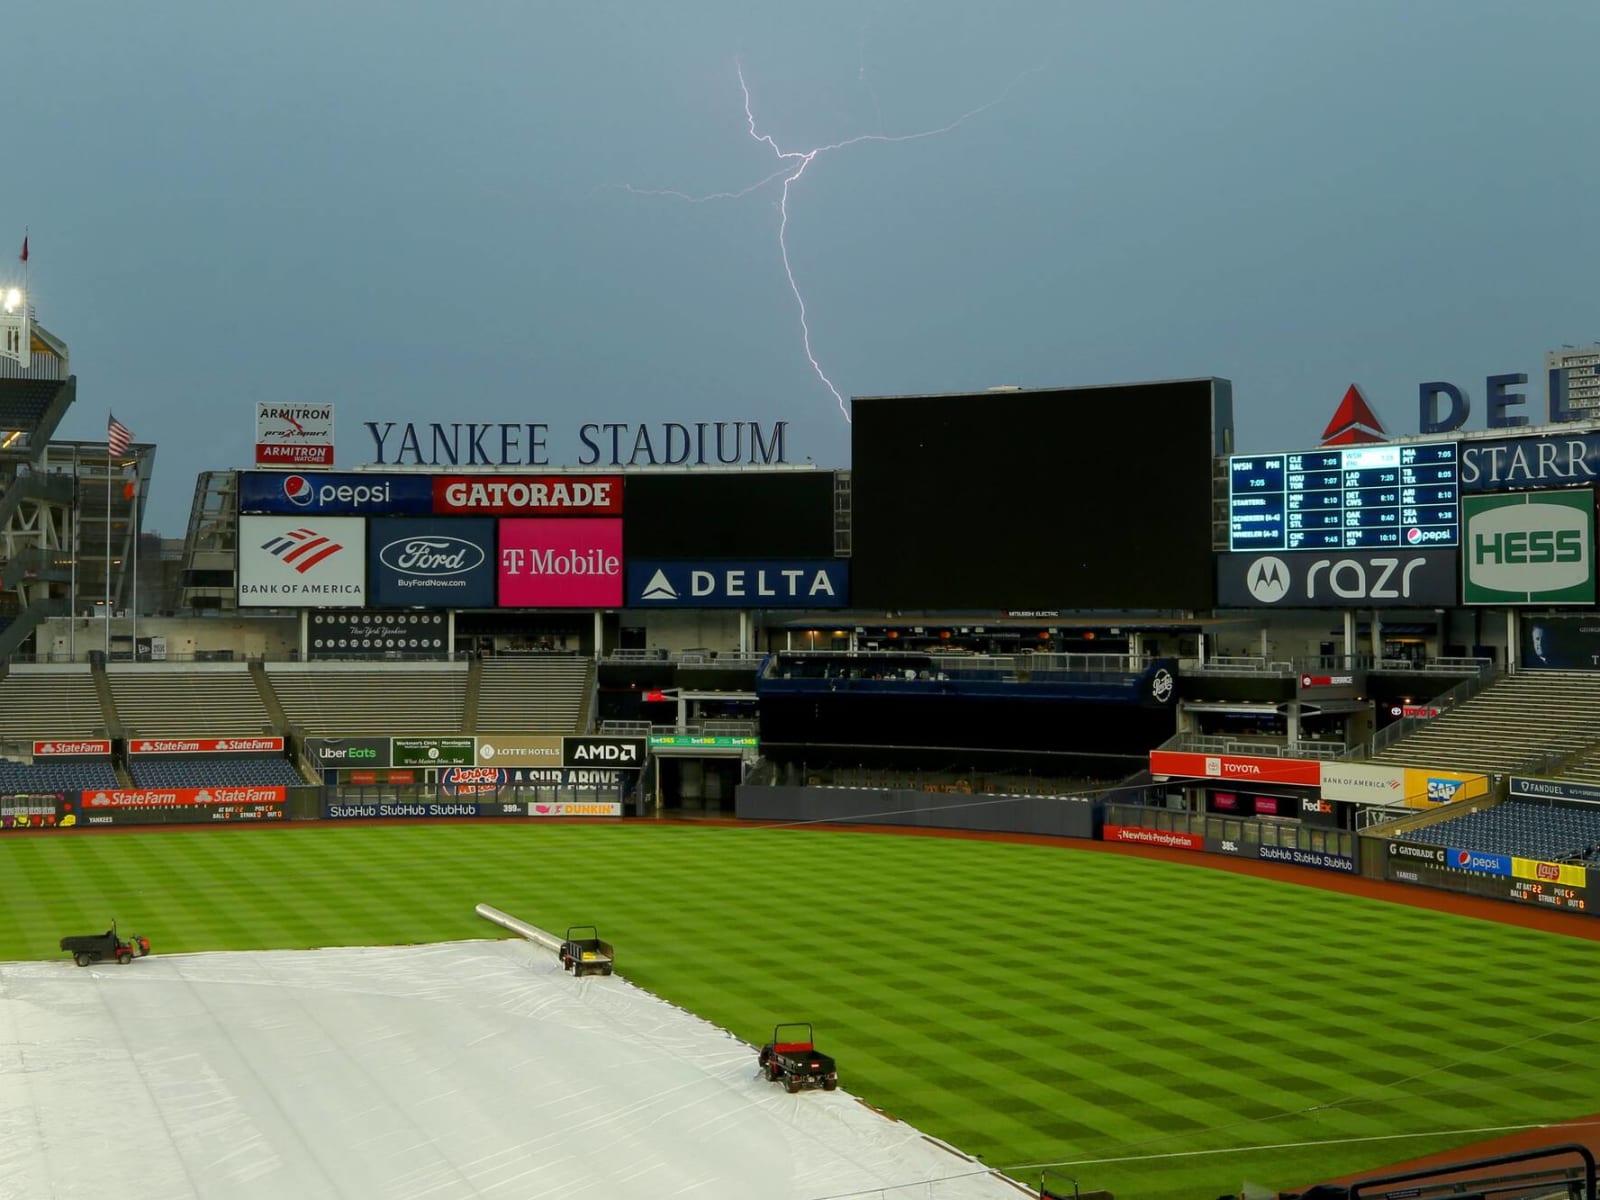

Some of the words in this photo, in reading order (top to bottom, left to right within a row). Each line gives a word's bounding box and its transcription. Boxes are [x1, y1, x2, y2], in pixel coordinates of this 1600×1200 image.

[1419, 363, 1600, 434] DEL
[260, 408, 330, 420] ARMITRON
[363, 422, 550, 466] YANKEE
[578, 420, 790, 465] STADIUM
[264, 446, 326, 456] ARMITRON
[1232, 462, 1253, 471] WSH
[1265, 460, 1280, 470] PHI
[1461, 440, 1597, 484] STARR
[1250, 479, 1266, 487] 7:05
[319, 482, 390, 507] pepsi
[445, 482, 611, 507] GATORADE
[1422, 529, 1451, 541] pepsi
[1475, 530, 1582, 565] HESS
[398, 540, 466, 569] Ford
[398, 578, 466, 588] BuyFordNow.com
[691, 570, 836, 596] DELTA
[1306, 557, 1426, 599] razr
[242, 584, 278, 594] BANK
[282, 584, 298, 594] OF
[301, 584, 361, 594] AMERICA
[320, 748, 347, 758] Uber
[348, 748, 376, 758] Eats
[497, 748, 527, 756] LOTTE
[528, 748, 560, 756] HOTELS
[574, 745, 620, 760] AMD
[450, 768, 498, 782] Jersey
[1224, 763, 1260, 774] TOYOTA
[1323, 777, 1342, 785] BANK
[1354, 779, 1386, 788] AMERICA
[1428, 782, 1456, 799] SAP
[1530, 784, 1564, 795] FANDUEL
[330, 806, 376, 817] StubHub
[380, 805, 426, 816] StubHub
[430, 804, 476, 815] StubHub
[565, 805, 615, 814] DUNKIN'
[1302, 799, 1332, 814] FedEx
[1260, 847, 1291, 860] StubHub
[1294, 851, 1322, 865] StubHub
[1324, 856, 1352, 870] StubHub
[1399, 846, 1434, 859] GATORADE
[1472, 857, 1500, 870] pepsi
[1510, 889, 1522, 898] BALL
